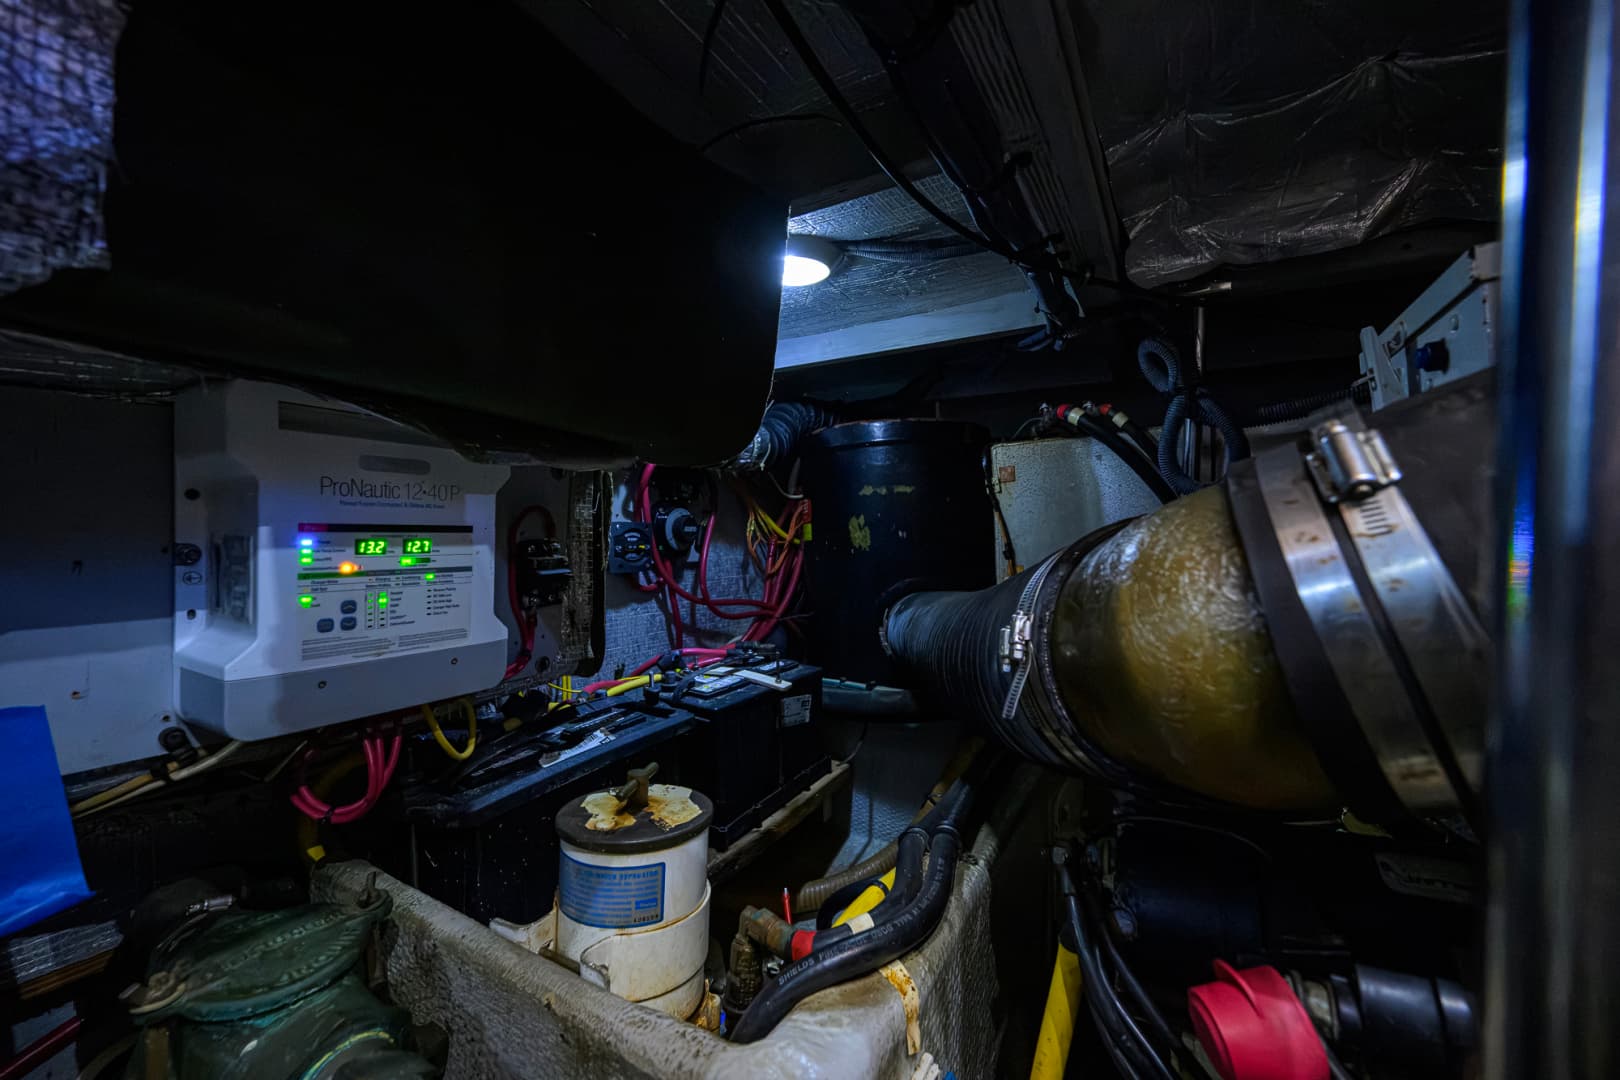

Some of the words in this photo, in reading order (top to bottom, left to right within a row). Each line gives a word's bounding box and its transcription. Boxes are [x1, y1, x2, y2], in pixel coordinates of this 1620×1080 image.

[320, 475, 401, 500] ProNautic
[359, 540, 386, 554] 13.2
[406, 540, 431, 553] 12.7
[777, 957, 816, 987] SHIELDS
